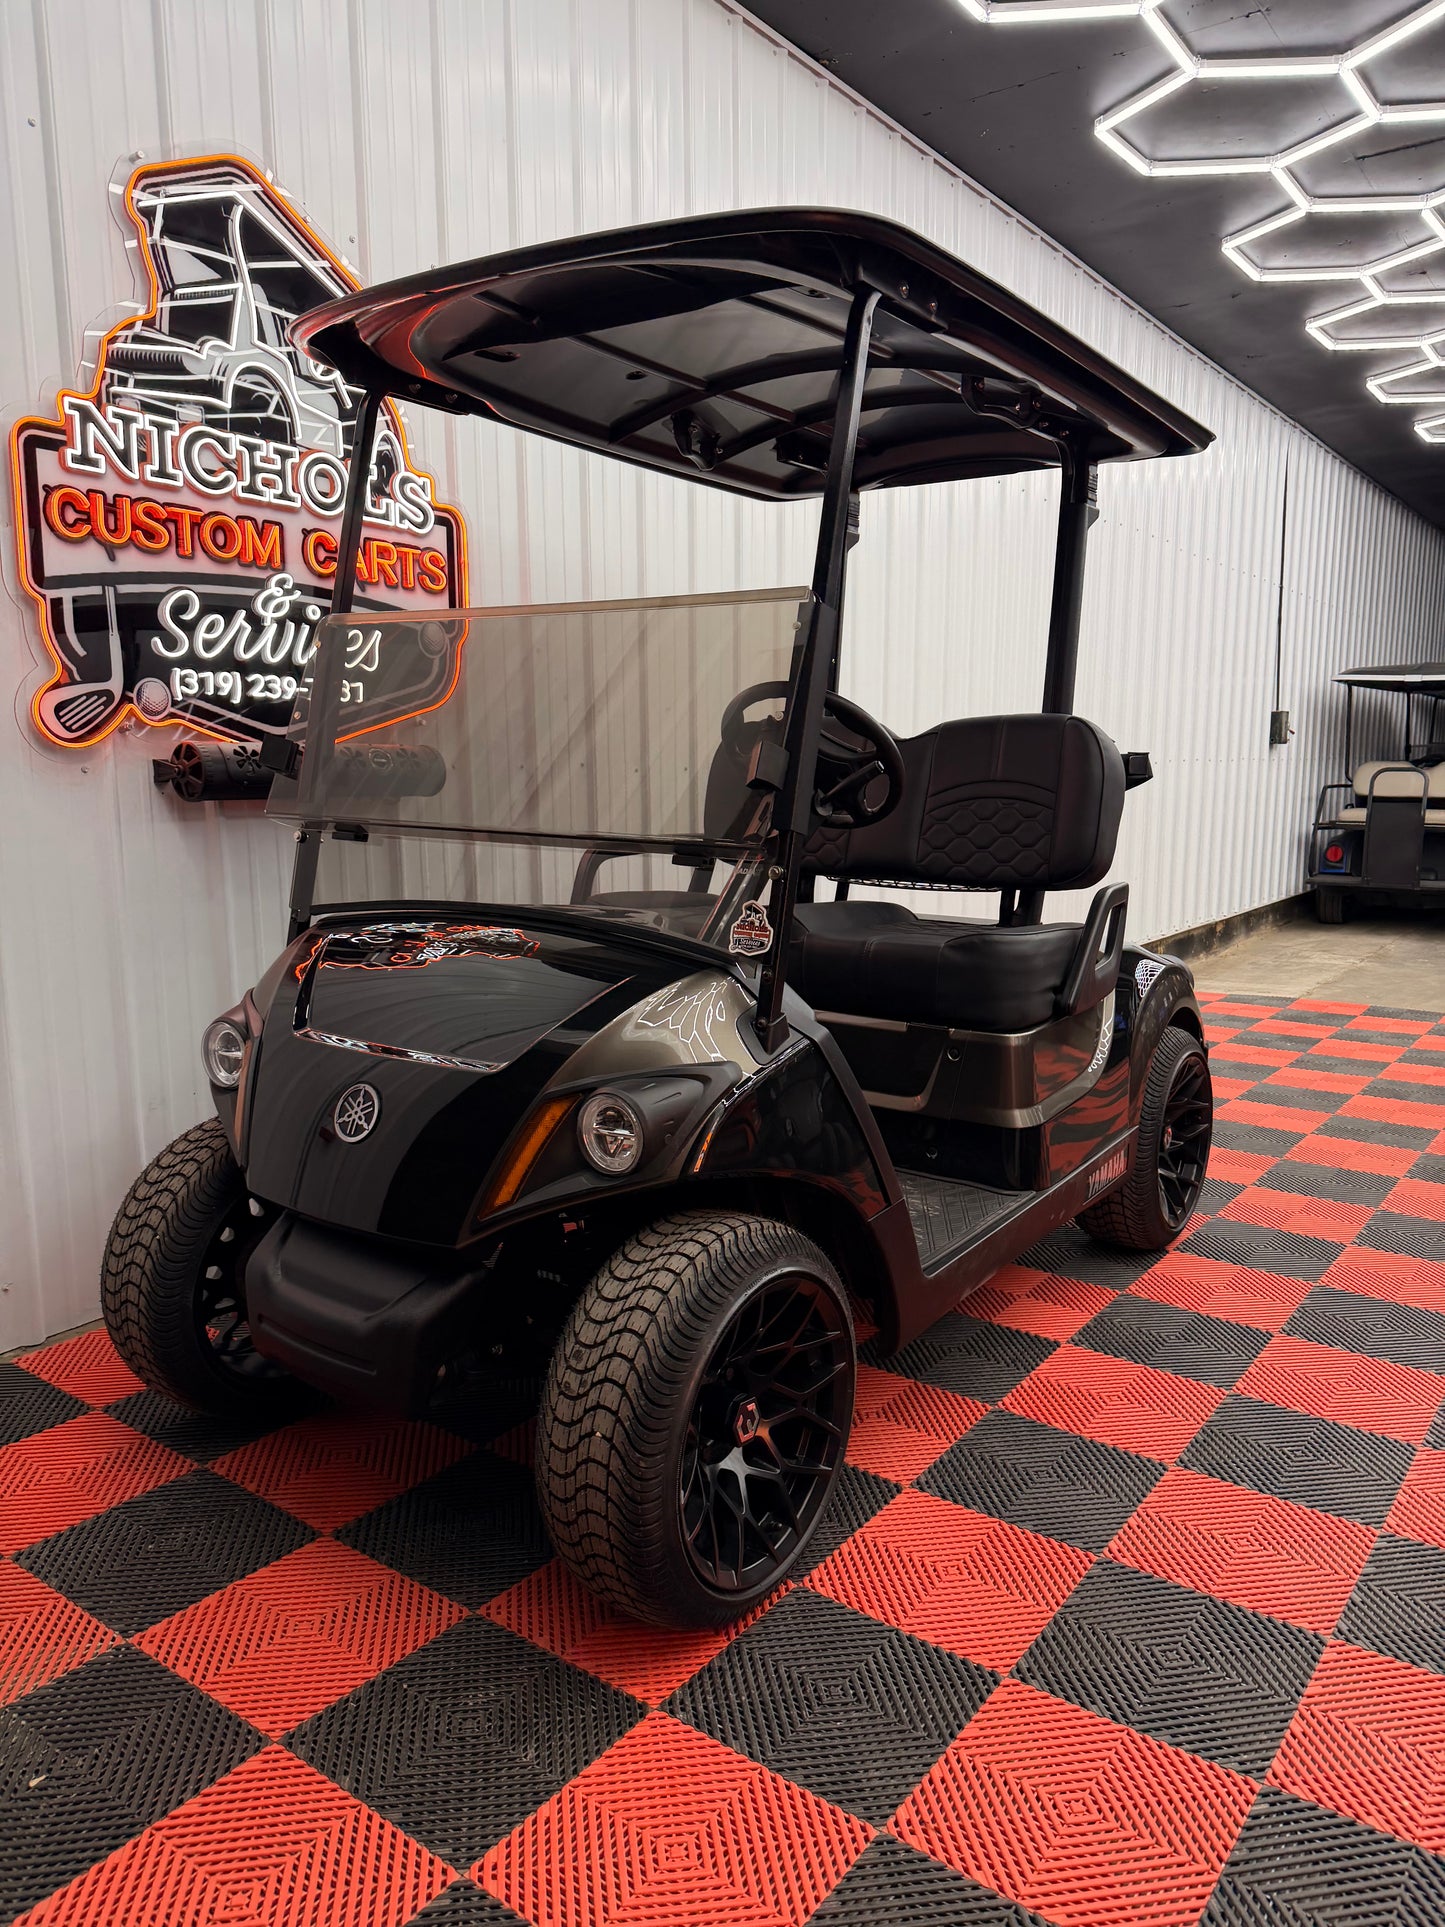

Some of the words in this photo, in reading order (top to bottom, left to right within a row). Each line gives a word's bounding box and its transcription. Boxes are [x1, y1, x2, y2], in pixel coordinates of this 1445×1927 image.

[62, 395, 435, 535] NICHOLS
[44, 484, 284, 571] CUSTOM
[151, 588, 383, 672] Servies
[253, 572, 302, 626] &
[170, 667, 242, 704] (319)
[1087, 1149, 1127, 1199] YAMAHA
